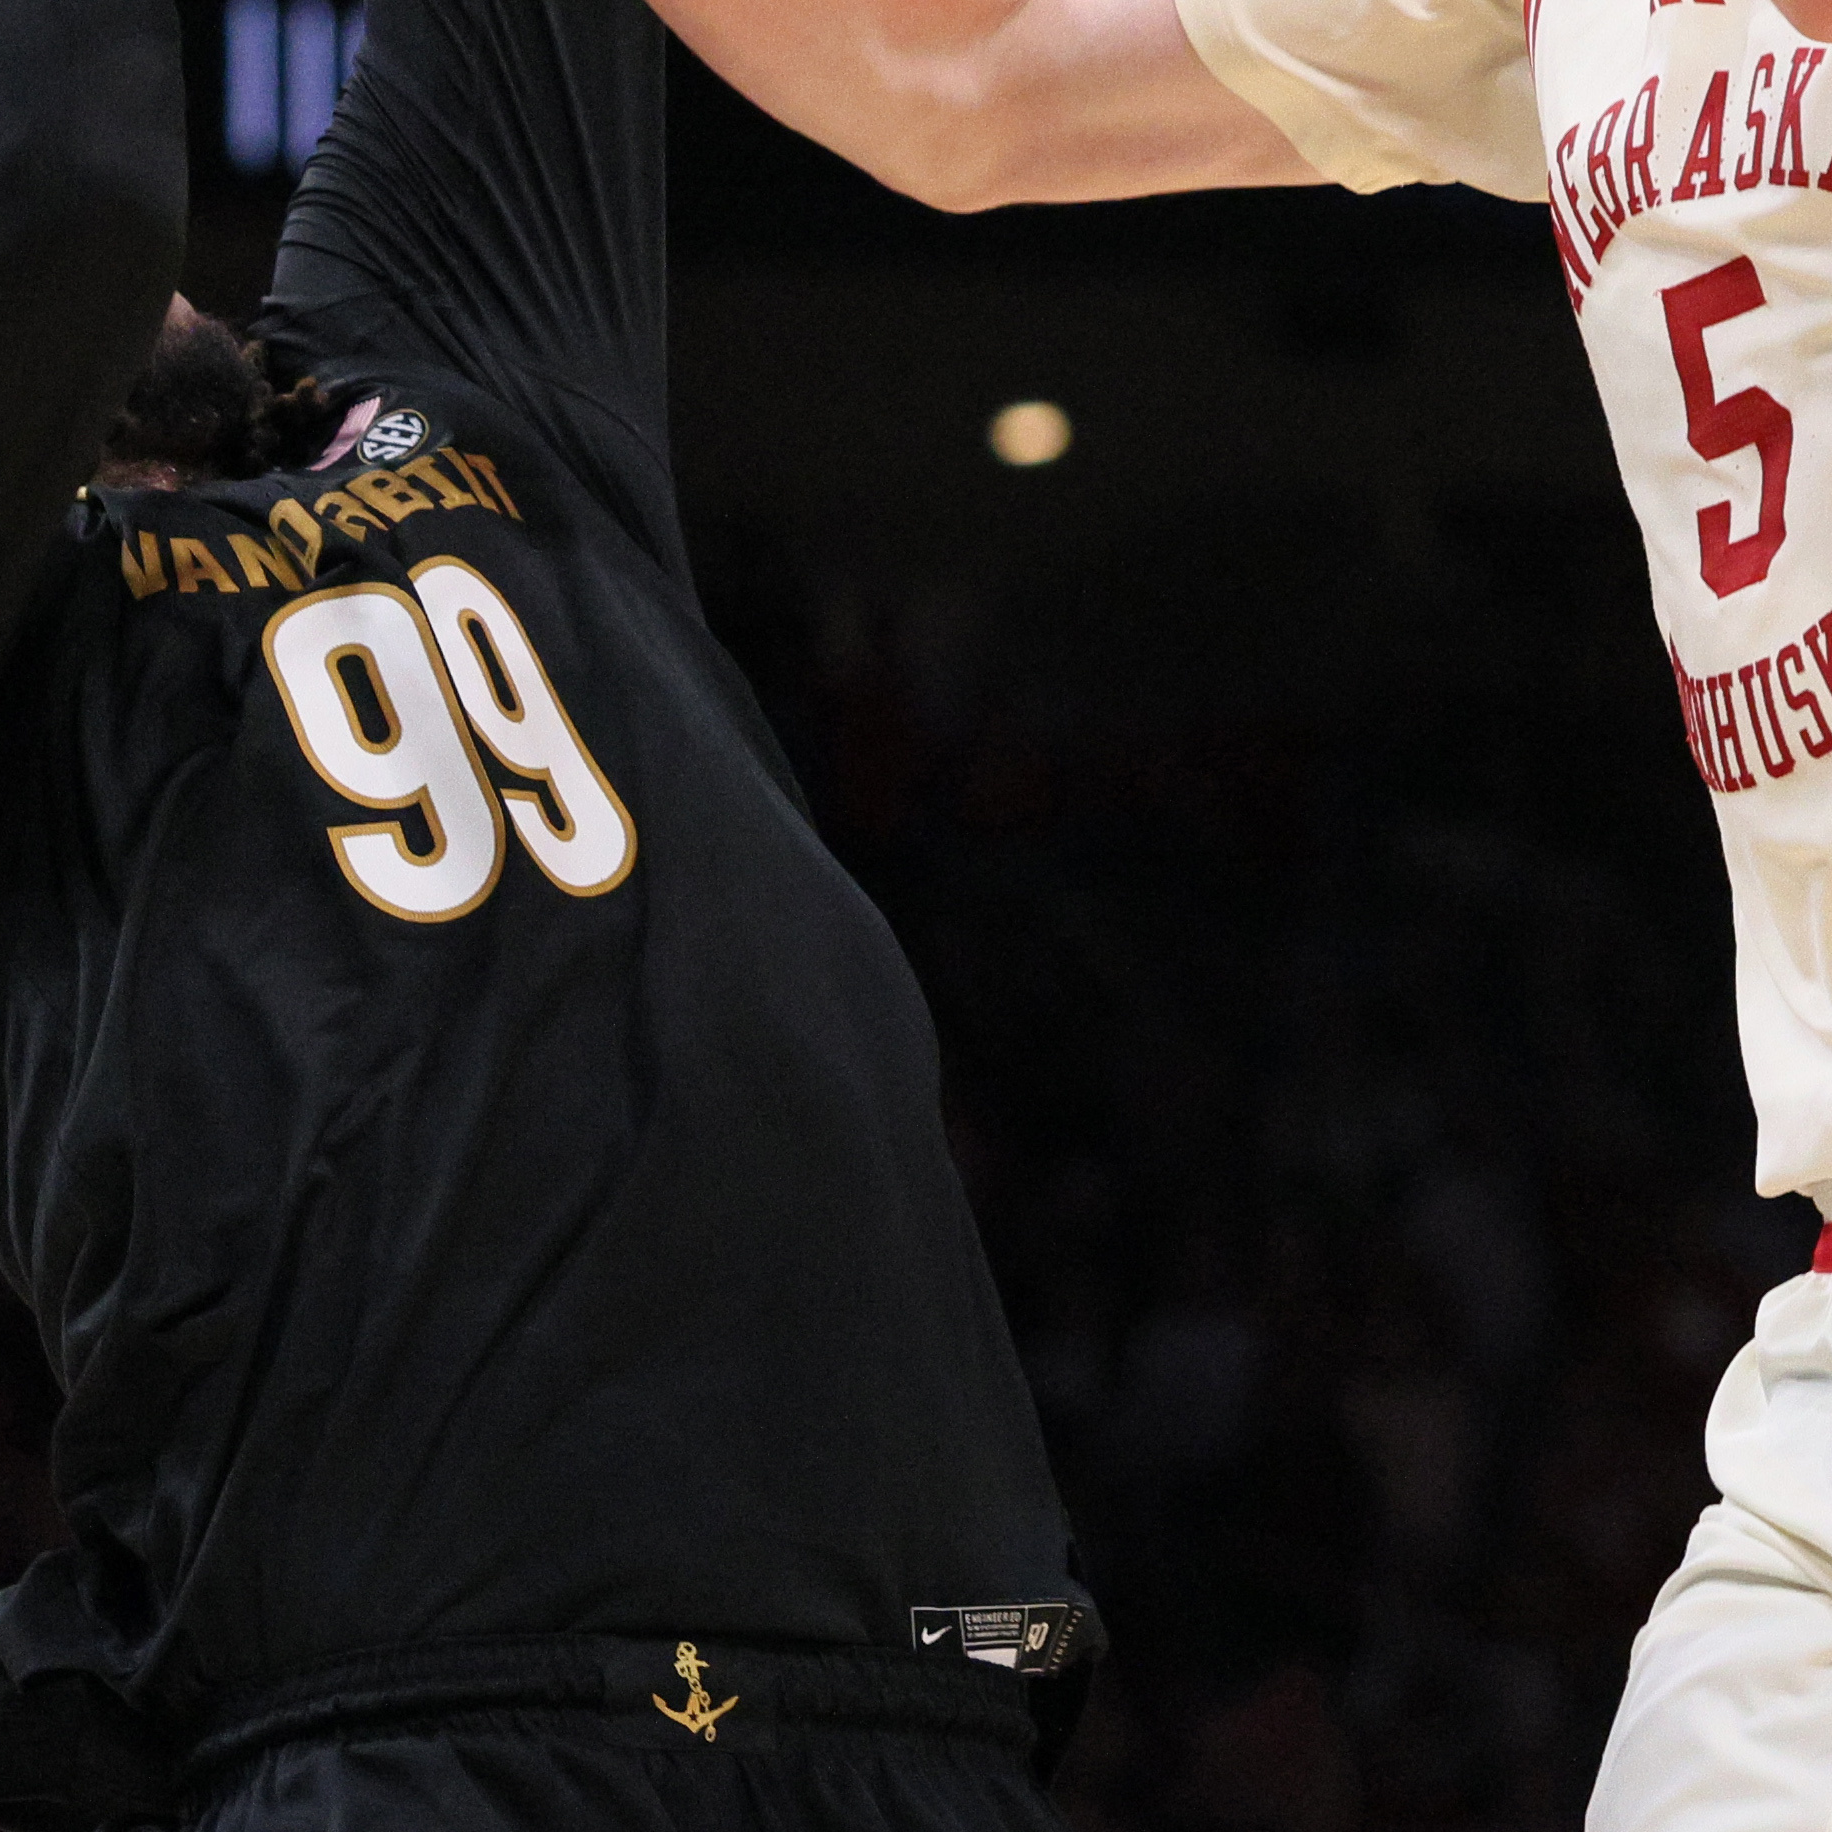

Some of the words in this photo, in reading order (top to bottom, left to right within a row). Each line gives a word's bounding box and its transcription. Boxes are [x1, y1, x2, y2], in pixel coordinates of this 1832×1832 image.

[362, 412, 424, 461] SEC
[1660, 255, 1794, 600] 5
[261, 554, 638, 924] 99
